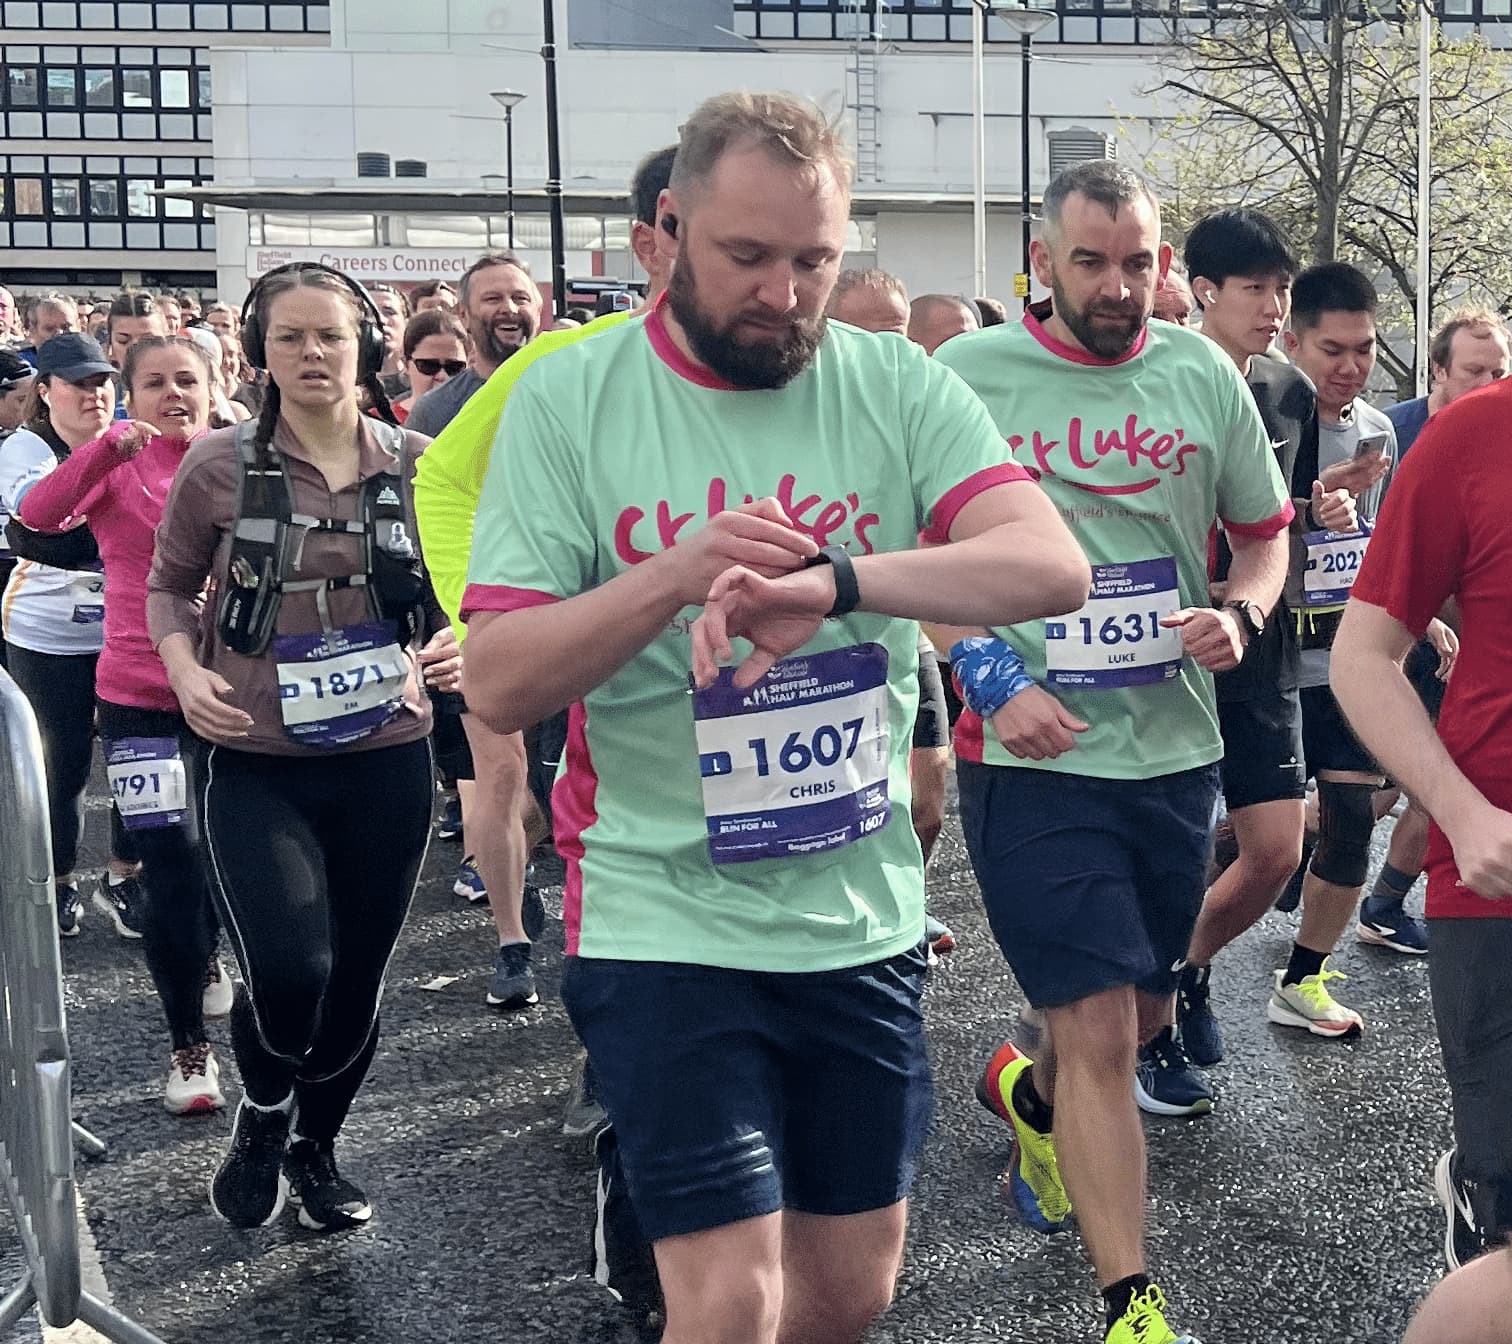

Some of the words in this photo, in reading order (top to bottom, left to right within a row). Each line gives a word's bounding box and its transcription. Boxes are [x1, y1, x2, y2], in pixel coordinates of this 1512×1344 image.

[320, 254, 388, 272] Careers
[392, 254, 467, 272] Connect
[1069, 414, 1198, 476] Luke's
[1080, 611, 1159, 645] 1631
[1108, 653, 1136, 664] LUKE
[311, 664, 384, 699] 1871
[769, 678, 819, 693] SHEFFIELD
[770, 690, 796, 704] HALF
[799, 680, 855, 700] MARATHON
[748, 716, 865, 777] 1607
[790, 779, 836, 799] CHRIS
[762, 820, 778, 829] ALL
[858, 811, 886, 834] 1607
